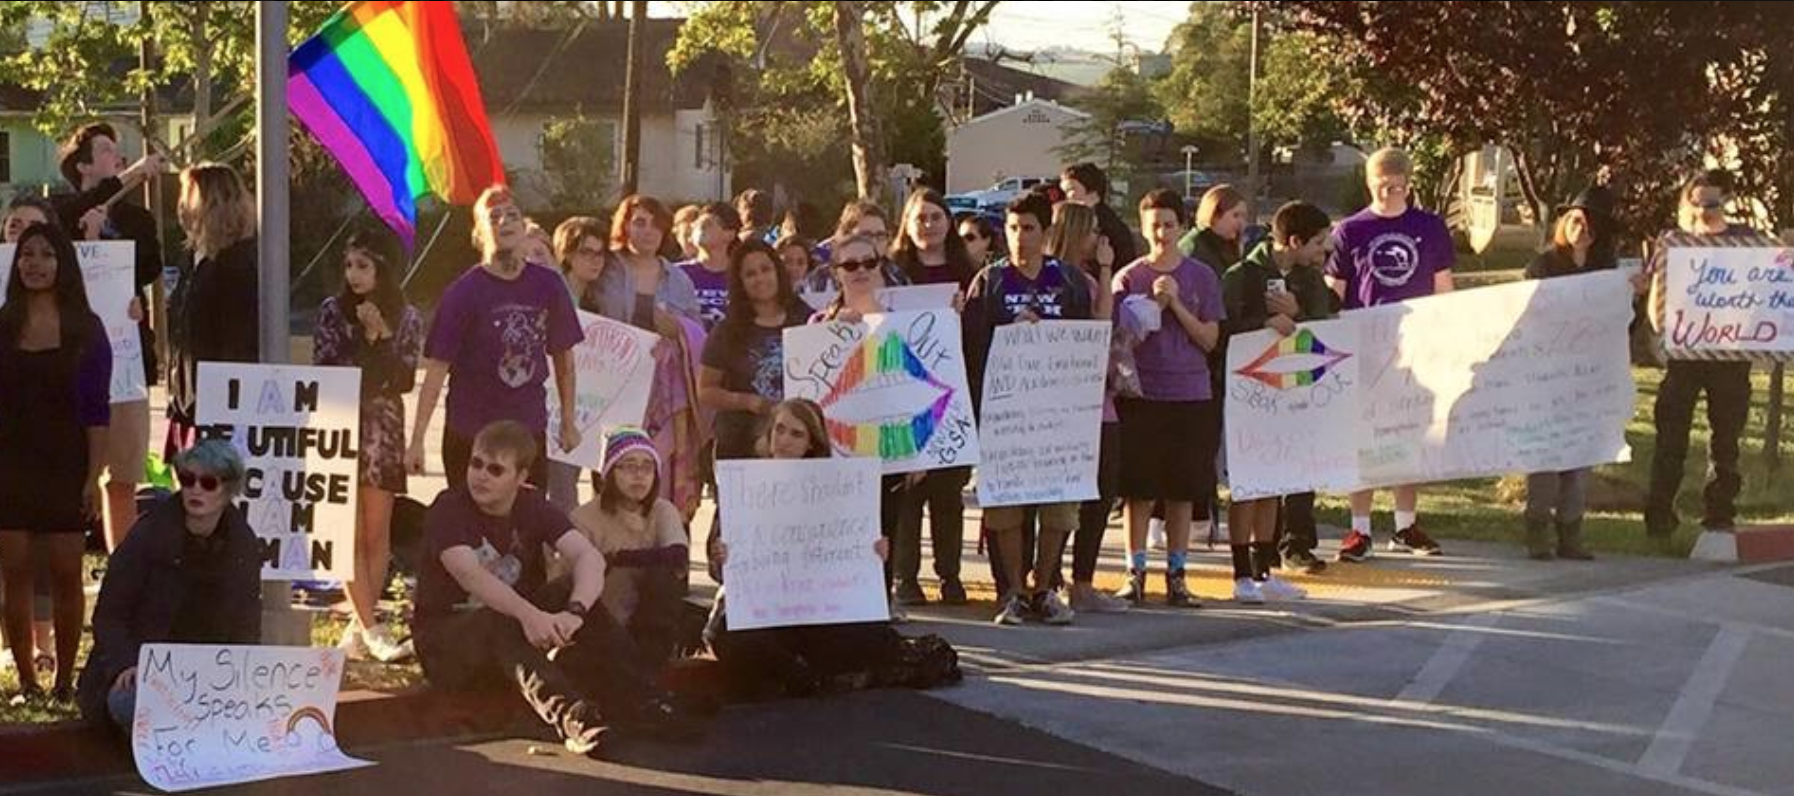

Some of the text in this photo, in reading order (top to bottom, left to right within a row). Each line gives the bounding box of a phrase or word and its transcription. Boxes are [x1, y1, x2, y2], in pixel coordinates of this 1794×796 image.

[1686, 258, 1793, 295] You are
[1673, 309, 1777, 349] WORLD
[227, 379, 239, 410] I
[244, 466, 350, 504] CAUSE
[144, 649, 198, 704] My
[209, 649, 322, 692] Silence
[153, 726, 197, 757] For
[224, 729, 271, 752] Me
